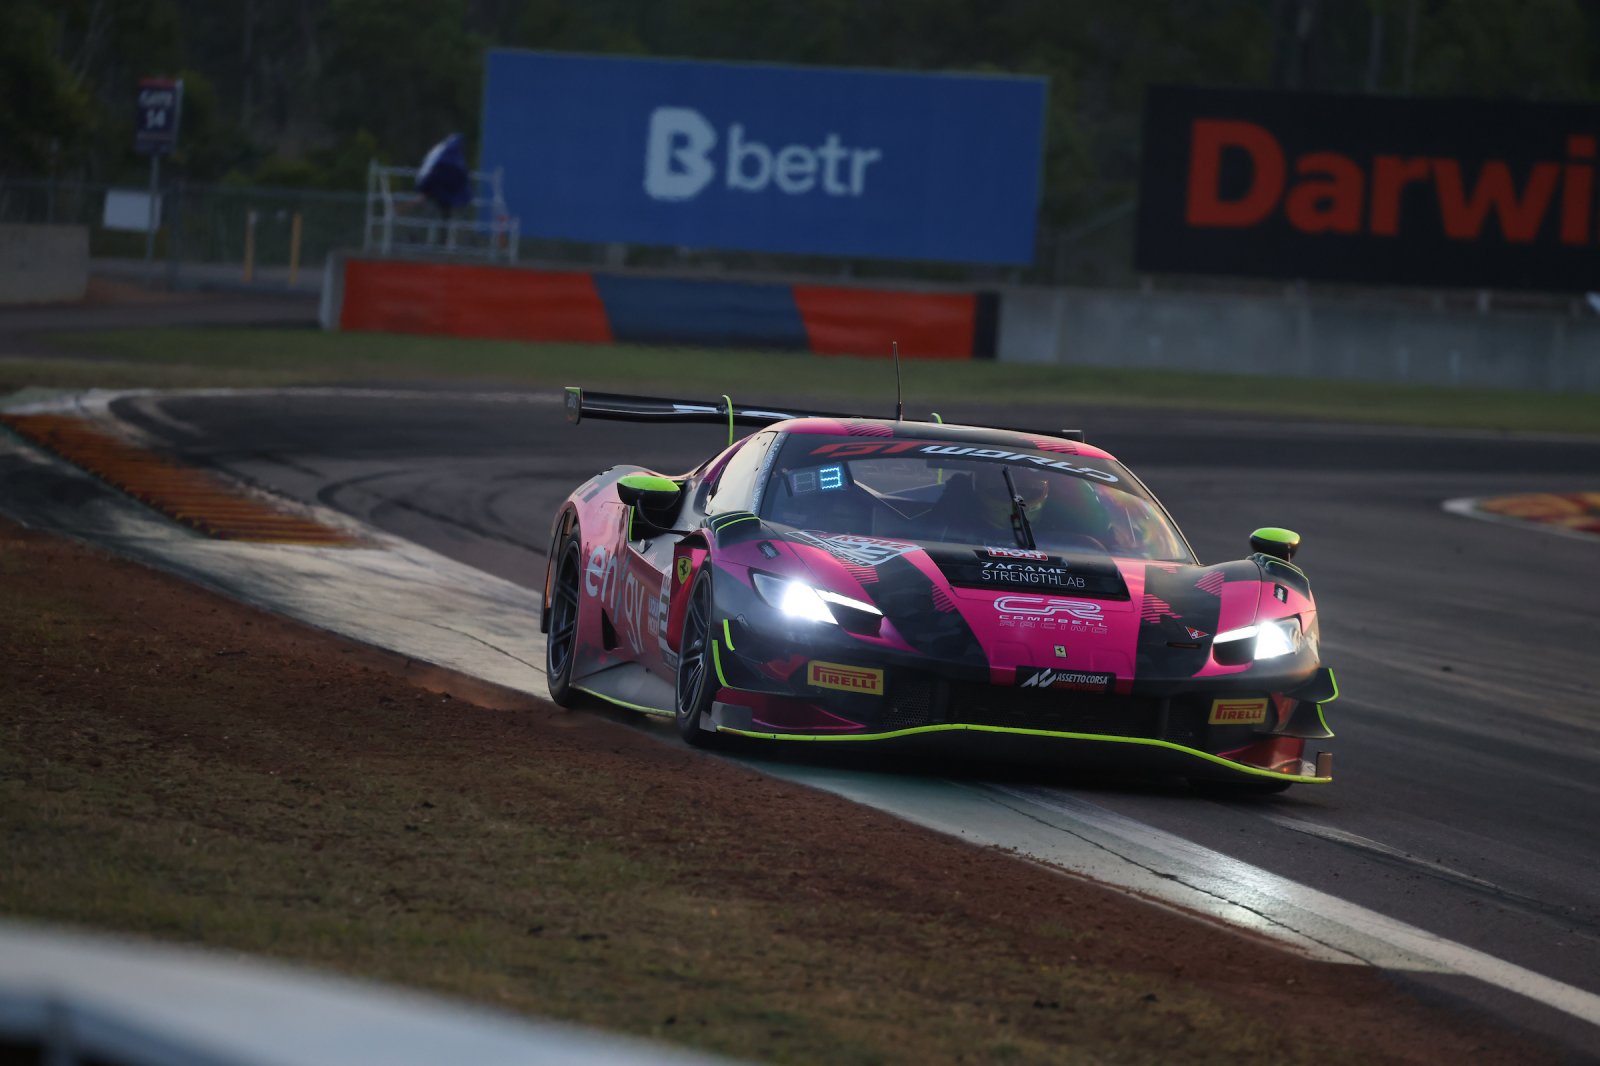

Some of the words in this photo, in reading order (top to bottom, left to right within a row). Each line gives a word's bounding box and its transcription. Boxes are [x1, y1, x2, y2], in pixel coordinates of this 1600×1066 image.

[725, 122, 882, 196] betr
[1185, 118, 1600, 245] Darwi
[918, 445, 1120, 483] WORLD
[981, 569, 1086, 588] STRENGTHLAB
[999, 615, 1108, 628] CAMPBELL
[999, 620, 1108, 635] RACING
[814, 664, 879, 690] PIRELLI
[1055, 672, 1086, 684] ASSETTO
[1086, 675, 1108, 685] CORSA
[1215, 702, 1264, 721] PIRELLI
